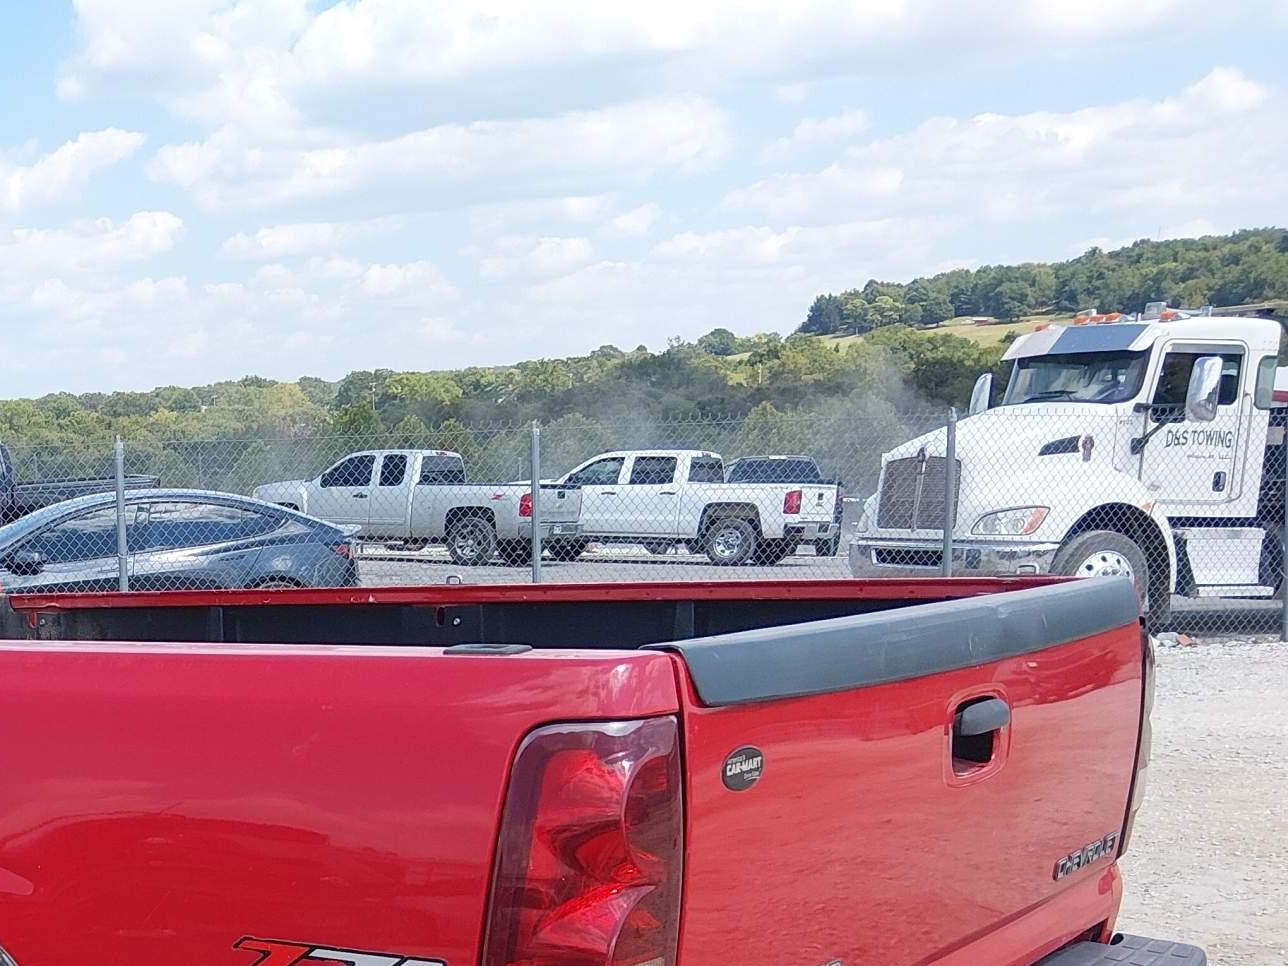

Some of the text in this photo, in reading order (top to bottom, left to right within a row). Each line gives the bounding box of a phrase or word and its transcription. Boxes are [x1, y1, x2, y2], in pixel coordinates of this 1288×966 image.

[1165, 429, 1233, 449] D&S TOWING
[726, 756, 762, 777] CAR-MART
[1053, 831, 1119, 881] CHEVROLET
